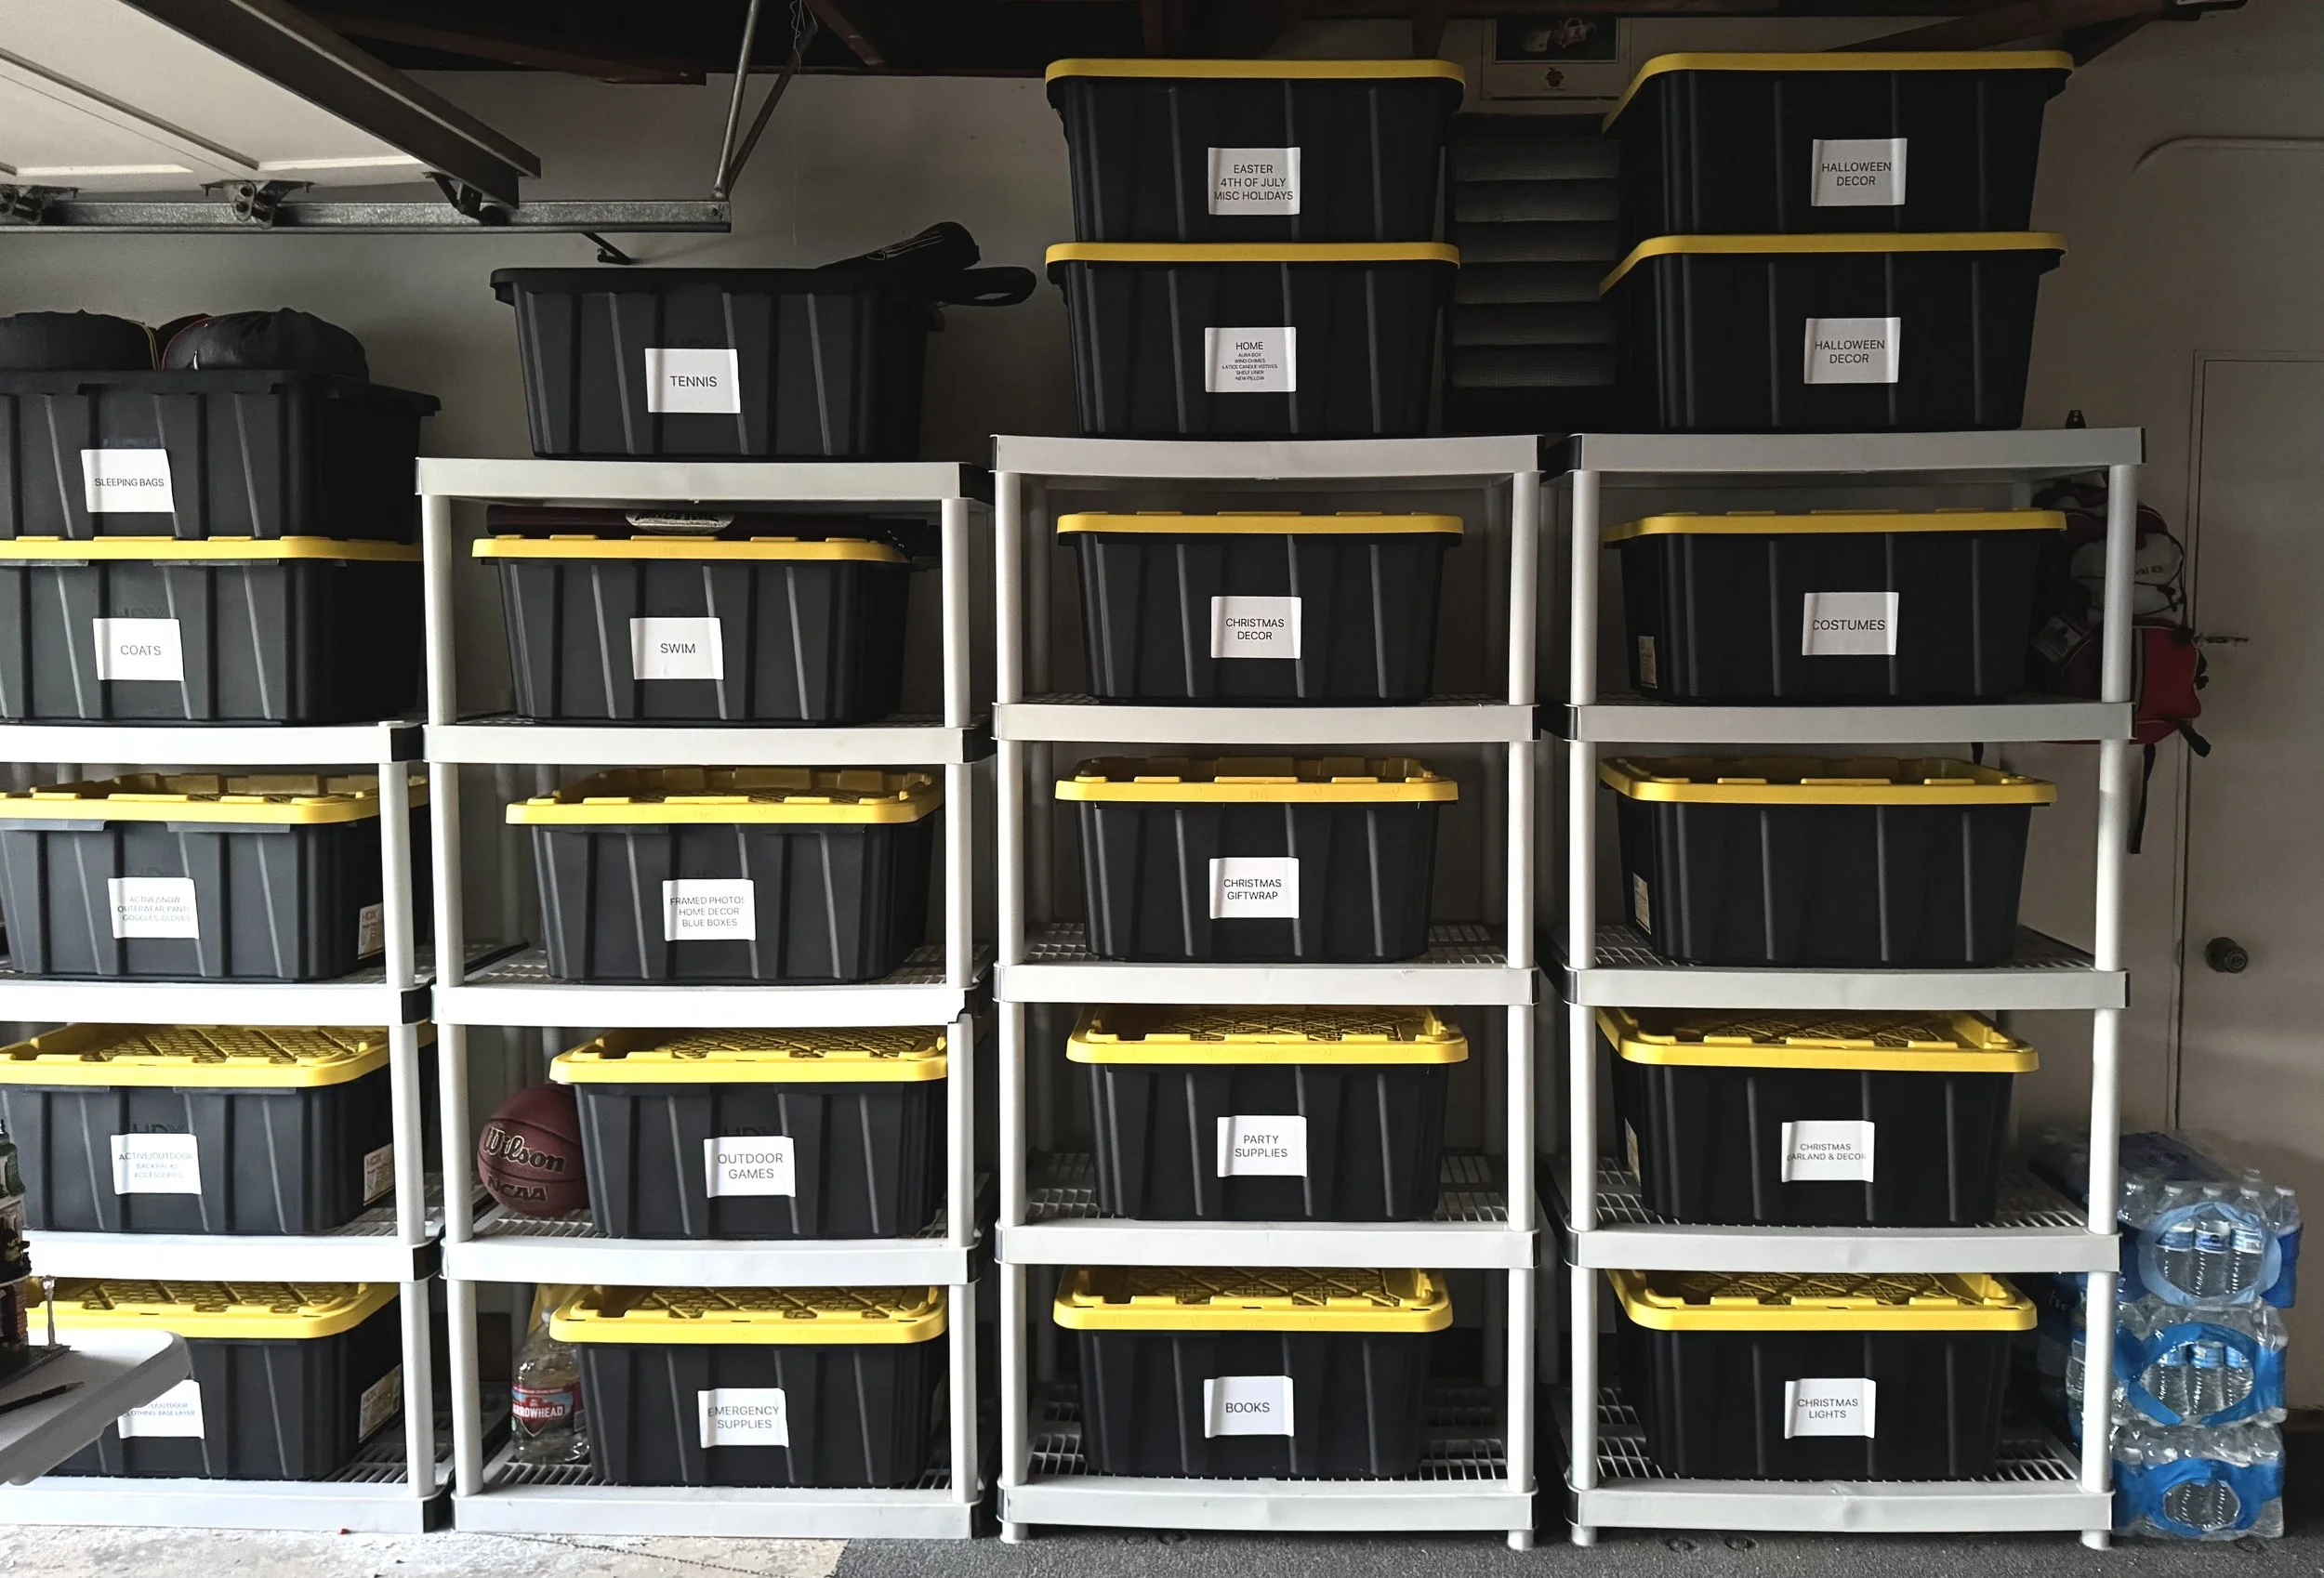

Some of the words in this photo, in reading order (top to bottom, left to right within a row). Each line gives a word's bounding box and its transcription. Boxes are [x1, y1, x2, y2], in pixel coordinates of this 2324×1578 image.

[1234, 164, 1274, 174] EASTER
[1821, 162, 1892, 173] HALLOWEEN
[1221, 178, 1242, 187] 4TH
[1245, 178, 1258, 187] OF
[1261, 178, 1287, 187] JULY
[1836, 175, 1875, 186] DECOR
[1214, 191, 1240, 201] MISC
[1242, 191, 1293, 201] HOLIDAYS
[1815, 340, 1885, 350] HALLOWEEN
[1829, 353, 1868, 363] DECOR
[670, 376, 717, 388] TENNIS
[95, 478, 138, 487] SLEEPING
[139, 478, 165, 487] BAGS
[1225, 618, 1285, 628] CHRISTMAS
[1812, 620, 1885, 630] COSTUMES
[1237, 631, 1272, 640] DECOR
[120, 645, 162, 656] COATS
[660, 643, 695, 653] SWIM
[1223, 878, 1281, 888] CHRISTMAS
[670, 897, 706, 905] FRAMED
[1227, 891, 1278, 901] GIFTWRAP
[707, 918, 737, 927] BOXES
[1243, 1135, 1279, 1144] PARTY
[483, 1126, 566, 1174] Wilson
[1235, 1149, 1287, 1158] SUPPLIES
[119, 1152, 191, 1161] ACTIVE/OUTDOOR
[718, 1153, 784, 1164] OUTDOOR
[729, 1169, 774, 1179] GAMES
[487, 1175, 548, 1202] NCAA
[1225, 1402, 1270, 1413] BOOKS
[1797, 1399, 1858, 1407] CHRISTMAS
[707, 1406, 779, 1416] EMERGENCY
[1808, 1410, 1846, 1419] LIGHTS
[718, 1419, 772, 1428] SUPPLIES
